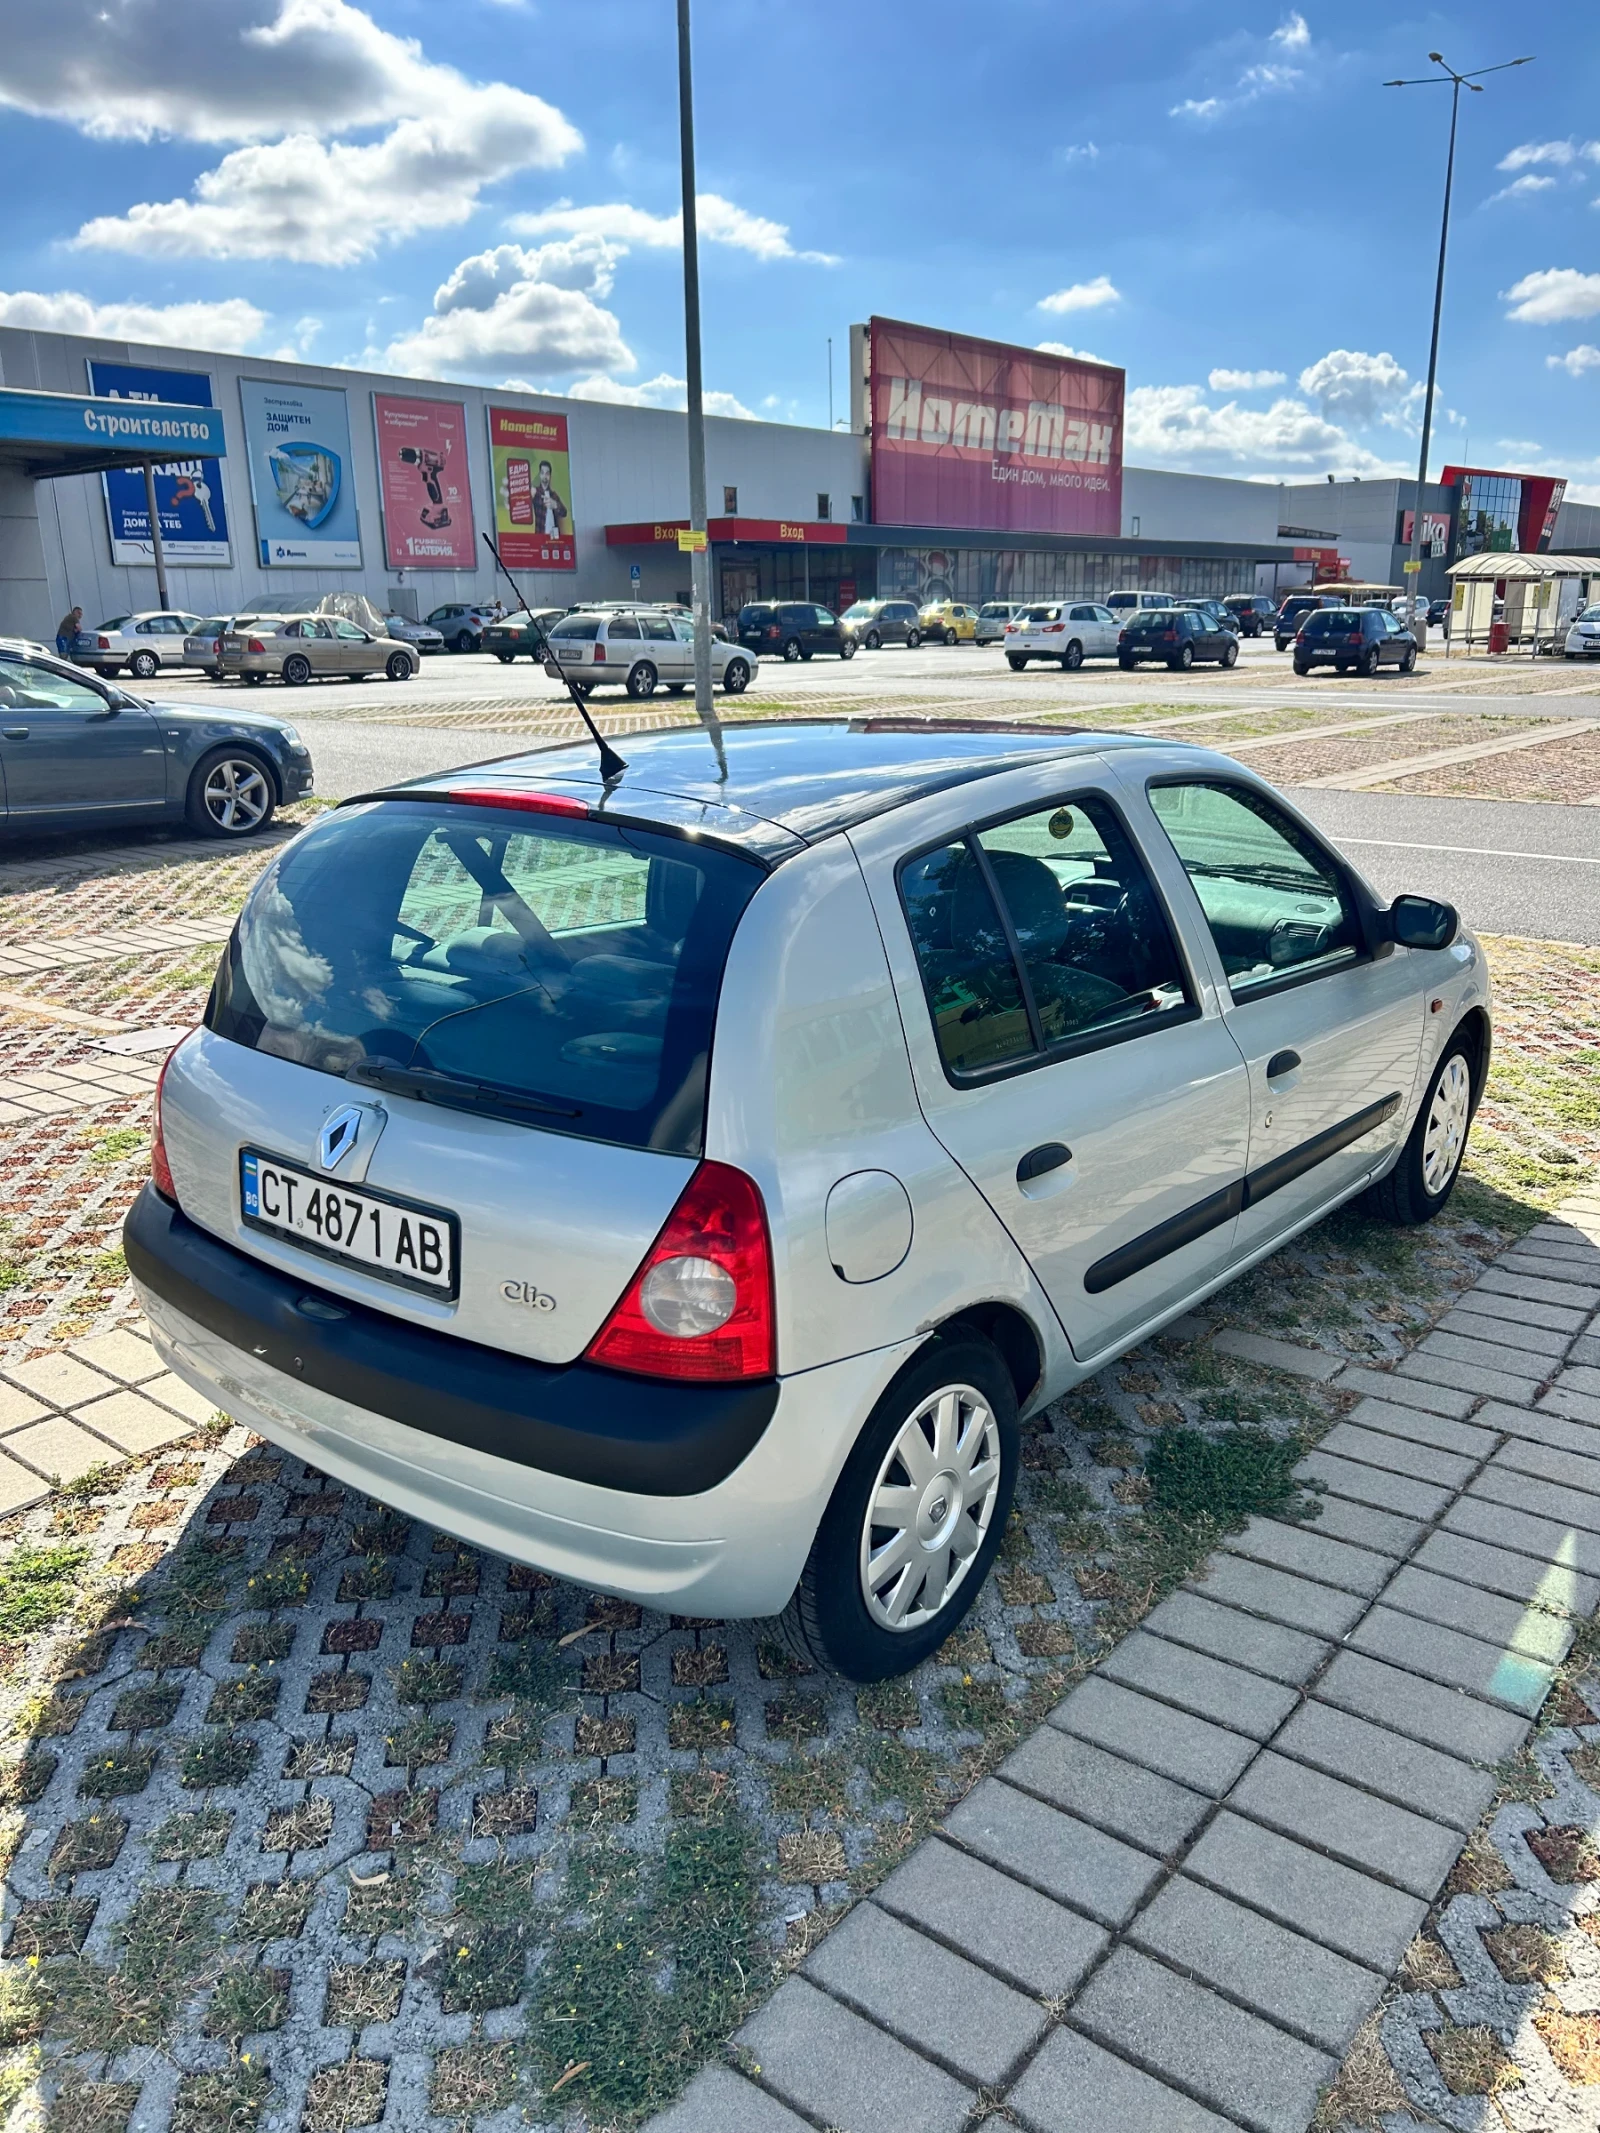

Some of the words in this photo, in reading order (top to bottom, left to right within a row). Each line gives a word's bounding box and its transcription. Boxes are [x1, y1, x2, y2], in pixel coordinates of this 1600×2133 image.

[84, 408, 209, 440] Строителство
[266, 412, 311, 425] ЗАЩИТЕН
[500, 418, 558, 436] HomeMax
[886, 377, 1114, 465] HomeMax
[267, 422, 289, 433] ДОМ
[509, 463, 529, 475] ЕДНО
[991, 459, 1019, 483] Един
[1021, 469, 1046, 488] дом,
[1049, 473, 1082, 489] много
[1084, 475, 1111, 492] идеи.
[123, 517, 147, 528] ДОМ
[163, 519, 182, 529] ТЕБ
[780, 523, 805, 540] Вход
[654, 525, 680, 540] Вход
[245, 1191, 259, 1208] BG
[261, 1169, 299, 1224] CT
[306, 1187, 382, 1258] 4871
[395, 1217, 443, 1276] AB
[499, 1279, 557, 1312] Clio
